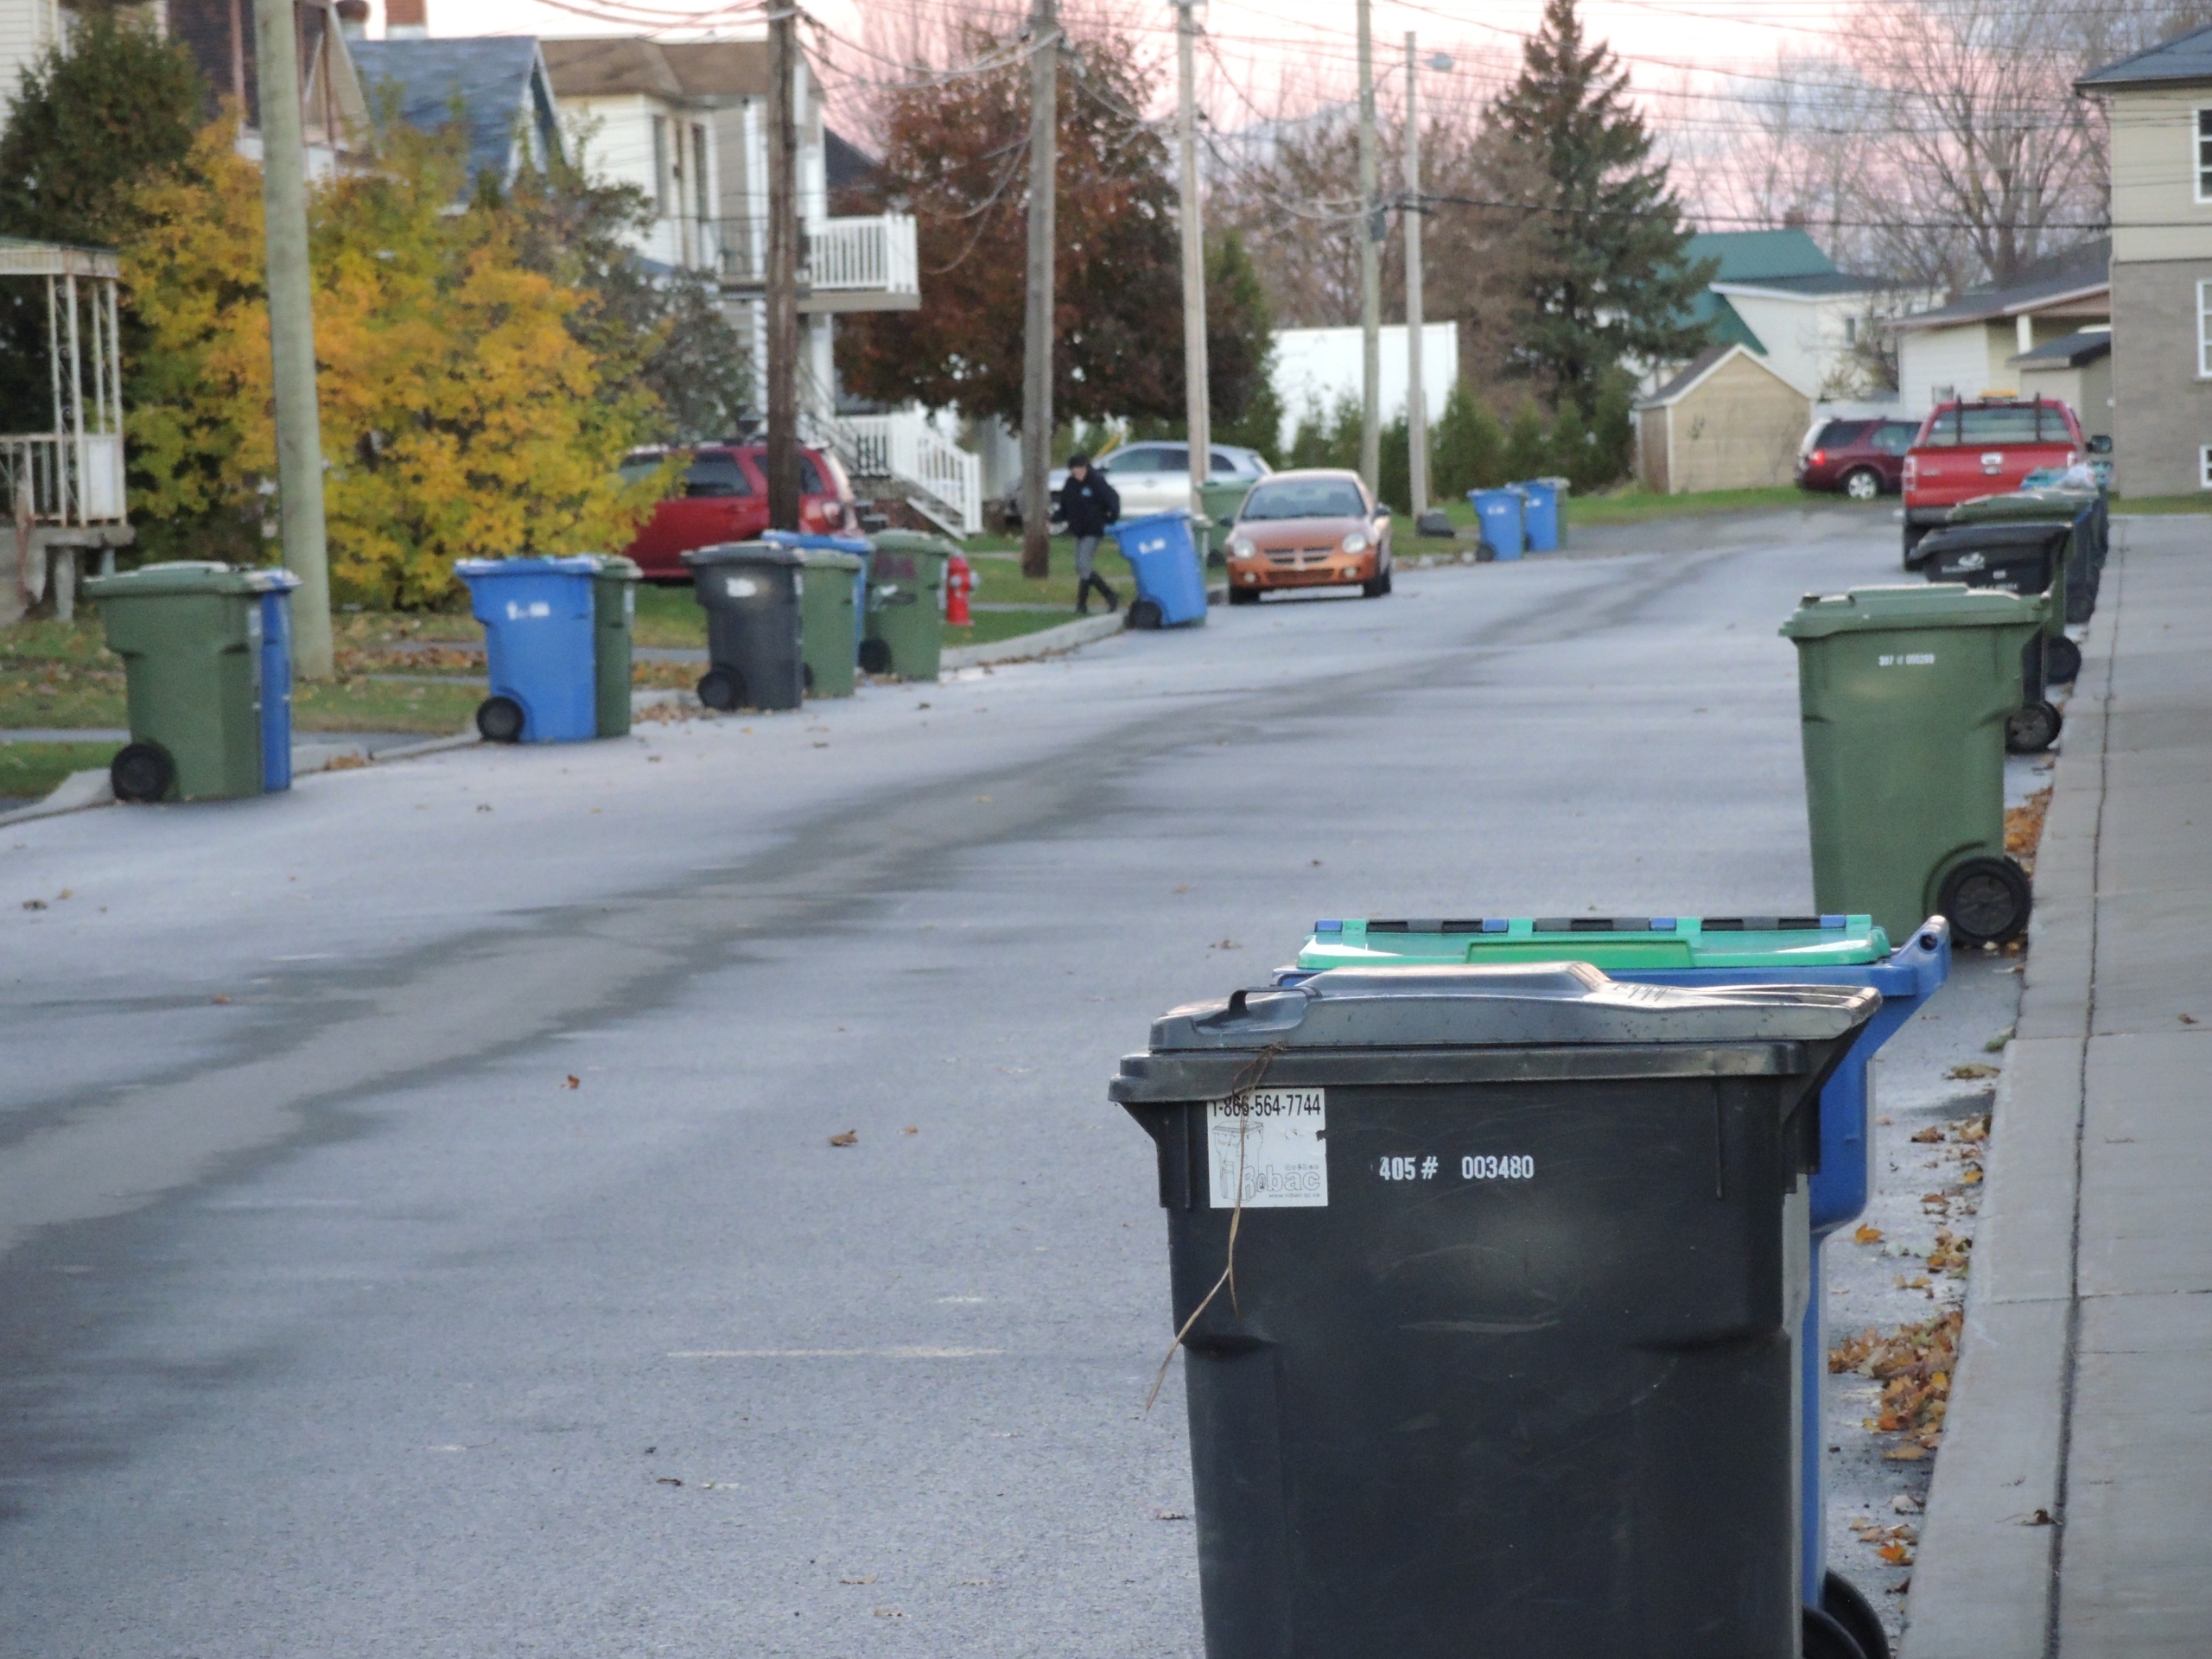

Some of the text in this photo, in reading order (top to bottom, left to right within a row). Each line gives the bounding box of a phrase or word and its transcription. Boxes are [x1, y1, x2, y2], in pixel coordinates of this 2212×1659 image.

[1212, 1094, 1321, 1116] 1-866-564-7744
[1379, 1155, 1535, 1180] 405 # 003480
